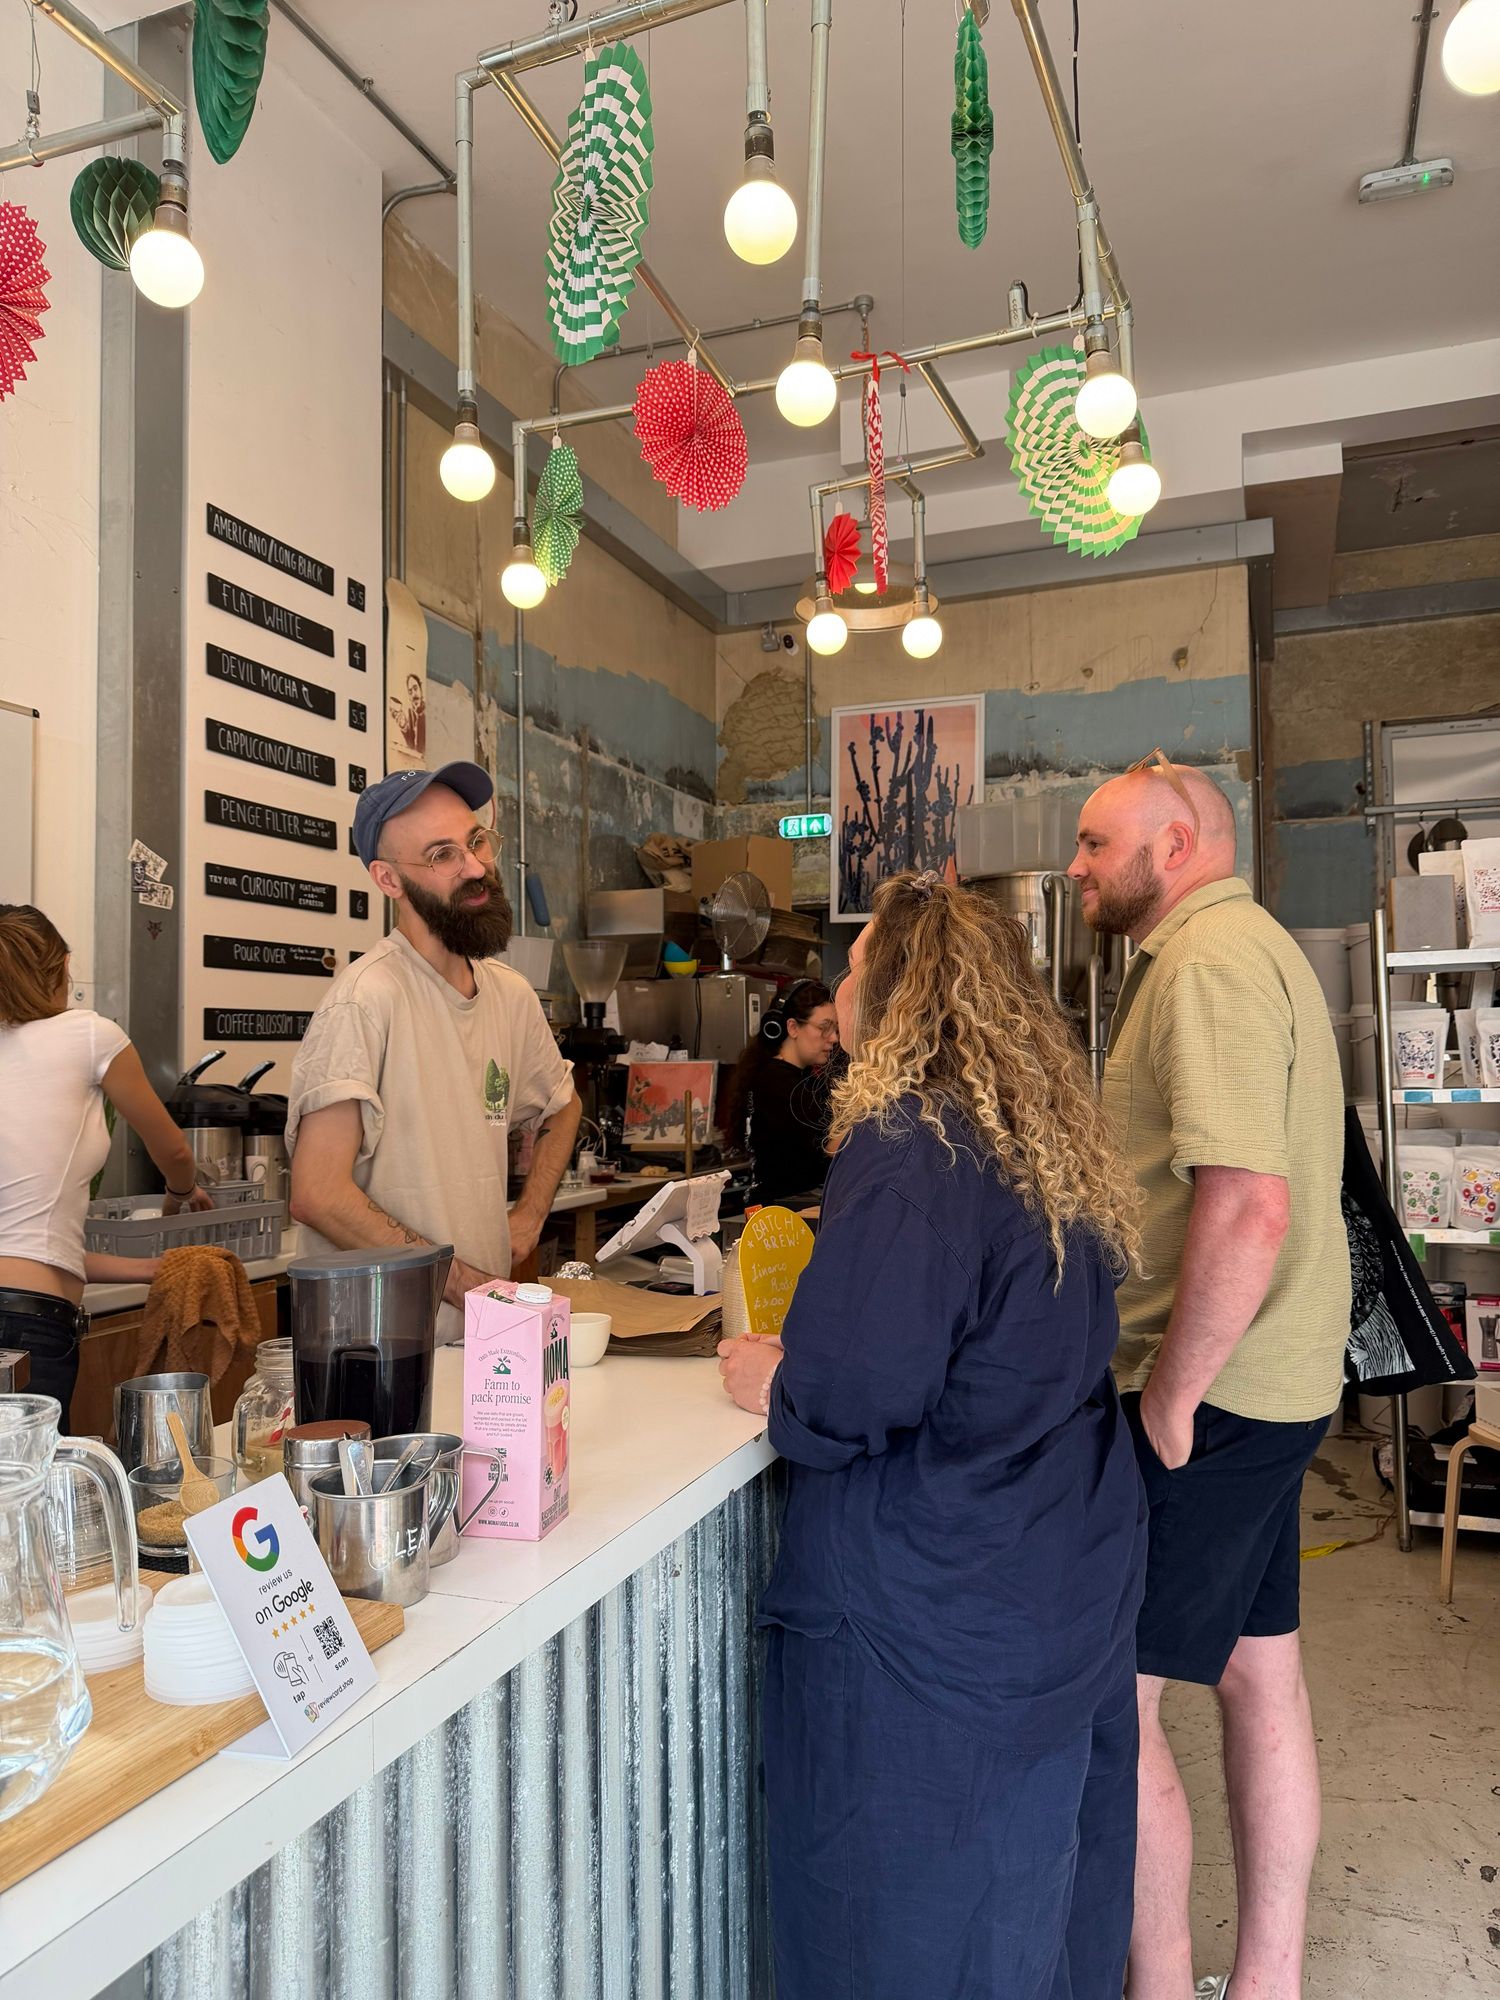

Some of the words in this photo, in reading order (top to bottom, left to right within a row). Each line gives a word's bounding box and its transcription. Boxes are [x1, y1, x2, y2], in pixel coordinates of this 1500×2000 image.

[213, 513, 297, 570] AMERICANO/LONG
[298, 555, 323, 586] BLACK
[221, 583, 255, 619] FLAT
[262, 600, 303, 640] WHITE
[353, 650, 361, 665] 4
[221, 653, 256, 686] DEVIL
[260, 667, 299, 699] MOCHA
[217, 727, 320, 778] CAPPUCCINO/LATTE
[221, 798, 262, 829] PENGE
[265, 810, 301, 837] FILTER
[208, 874, 222, 885] TRY
[223, 876, 238, 887] OUR
[241, 874, 296, 901] CURIOSITY
[356, 899, 363, 913] 6
[233, 943, 261, 962] POUR
[262, 946, 287, 964] OVER
[217, 1013, 255, 1035] COFFEE
[256, 1013, 293, 1035] BLOSSOM
[752, 1214, 794, 1241] BATCH
[763, 1232, 800, 1250] BREW!
[543, 1335, 570, 1396] MOMA
[484, 1378, 509, 1391] Farm
[511, 1381, 521, 1391] to
[471, 1391, 493, 1405] pack
[495, 1393, 532, 1406] promise
[490, 1463, 507, 1473] GRT
[258, 1575, 283, 1595] review
[283, 1569, 293, 1580] us
[255, 1606, 273, 1625] on
[272, 1579, 314, 1613] Google
[308, 1654, 314, 1662] or
[335, 1656, 350, 1671] scan
[293, 1690, 306, 1704] tap
[318, 1677, 354, 1710] reviewcard.shop
